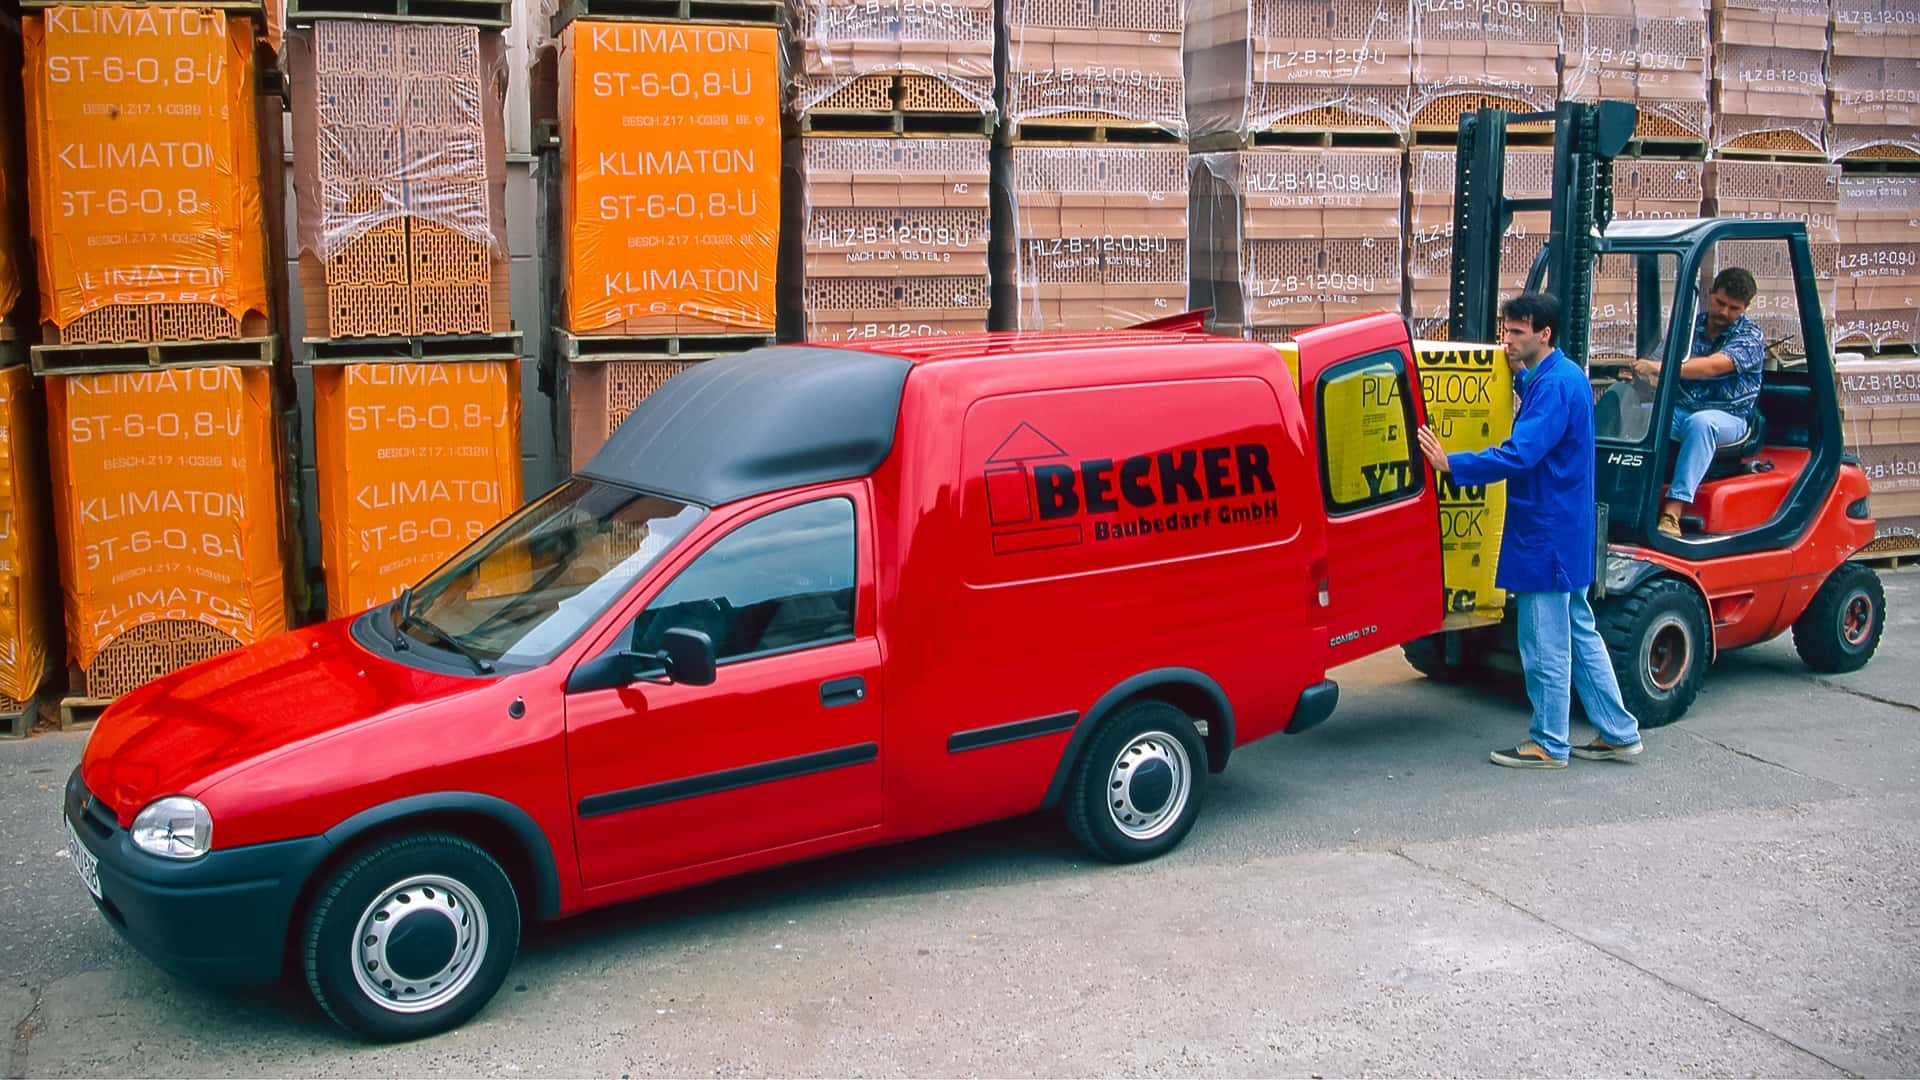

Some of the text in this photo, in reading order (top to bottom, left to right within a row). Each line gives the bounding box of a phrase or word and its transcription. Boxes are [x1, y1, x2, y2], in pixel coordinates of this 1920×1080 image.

[47, 8, 227, 37] KLIMATON
[592, 27, 749, 53] KLIMATON
[599, 149, 754, 176] KLIMATON
[953, 183, 968, 193] AC
[818, 226, 970, 249] HLZ-B-12-0,9-Ü
[1029, 232, 1167, 258] HLZ-B-12-0,9-Ü
[846, 252, 874, 263] NACH
[879, 251, 896, 260] DIN
[900, 250, 919, 261] 105
[922, 251, 941, 262] TEIL
[604, 268, 760, 297] KLIMATON
[69, 366, 242, 396] KLIMATON
[349, 363, 507, 386] KLIMATON
[1423, 374, 1490, 404] BLOCK
[1034, 443, 1276, 521] BECKER
[79, 489, 244, 526] KLIMATON
[1095, 498, 1279, 542] Baubedarf GmbH
